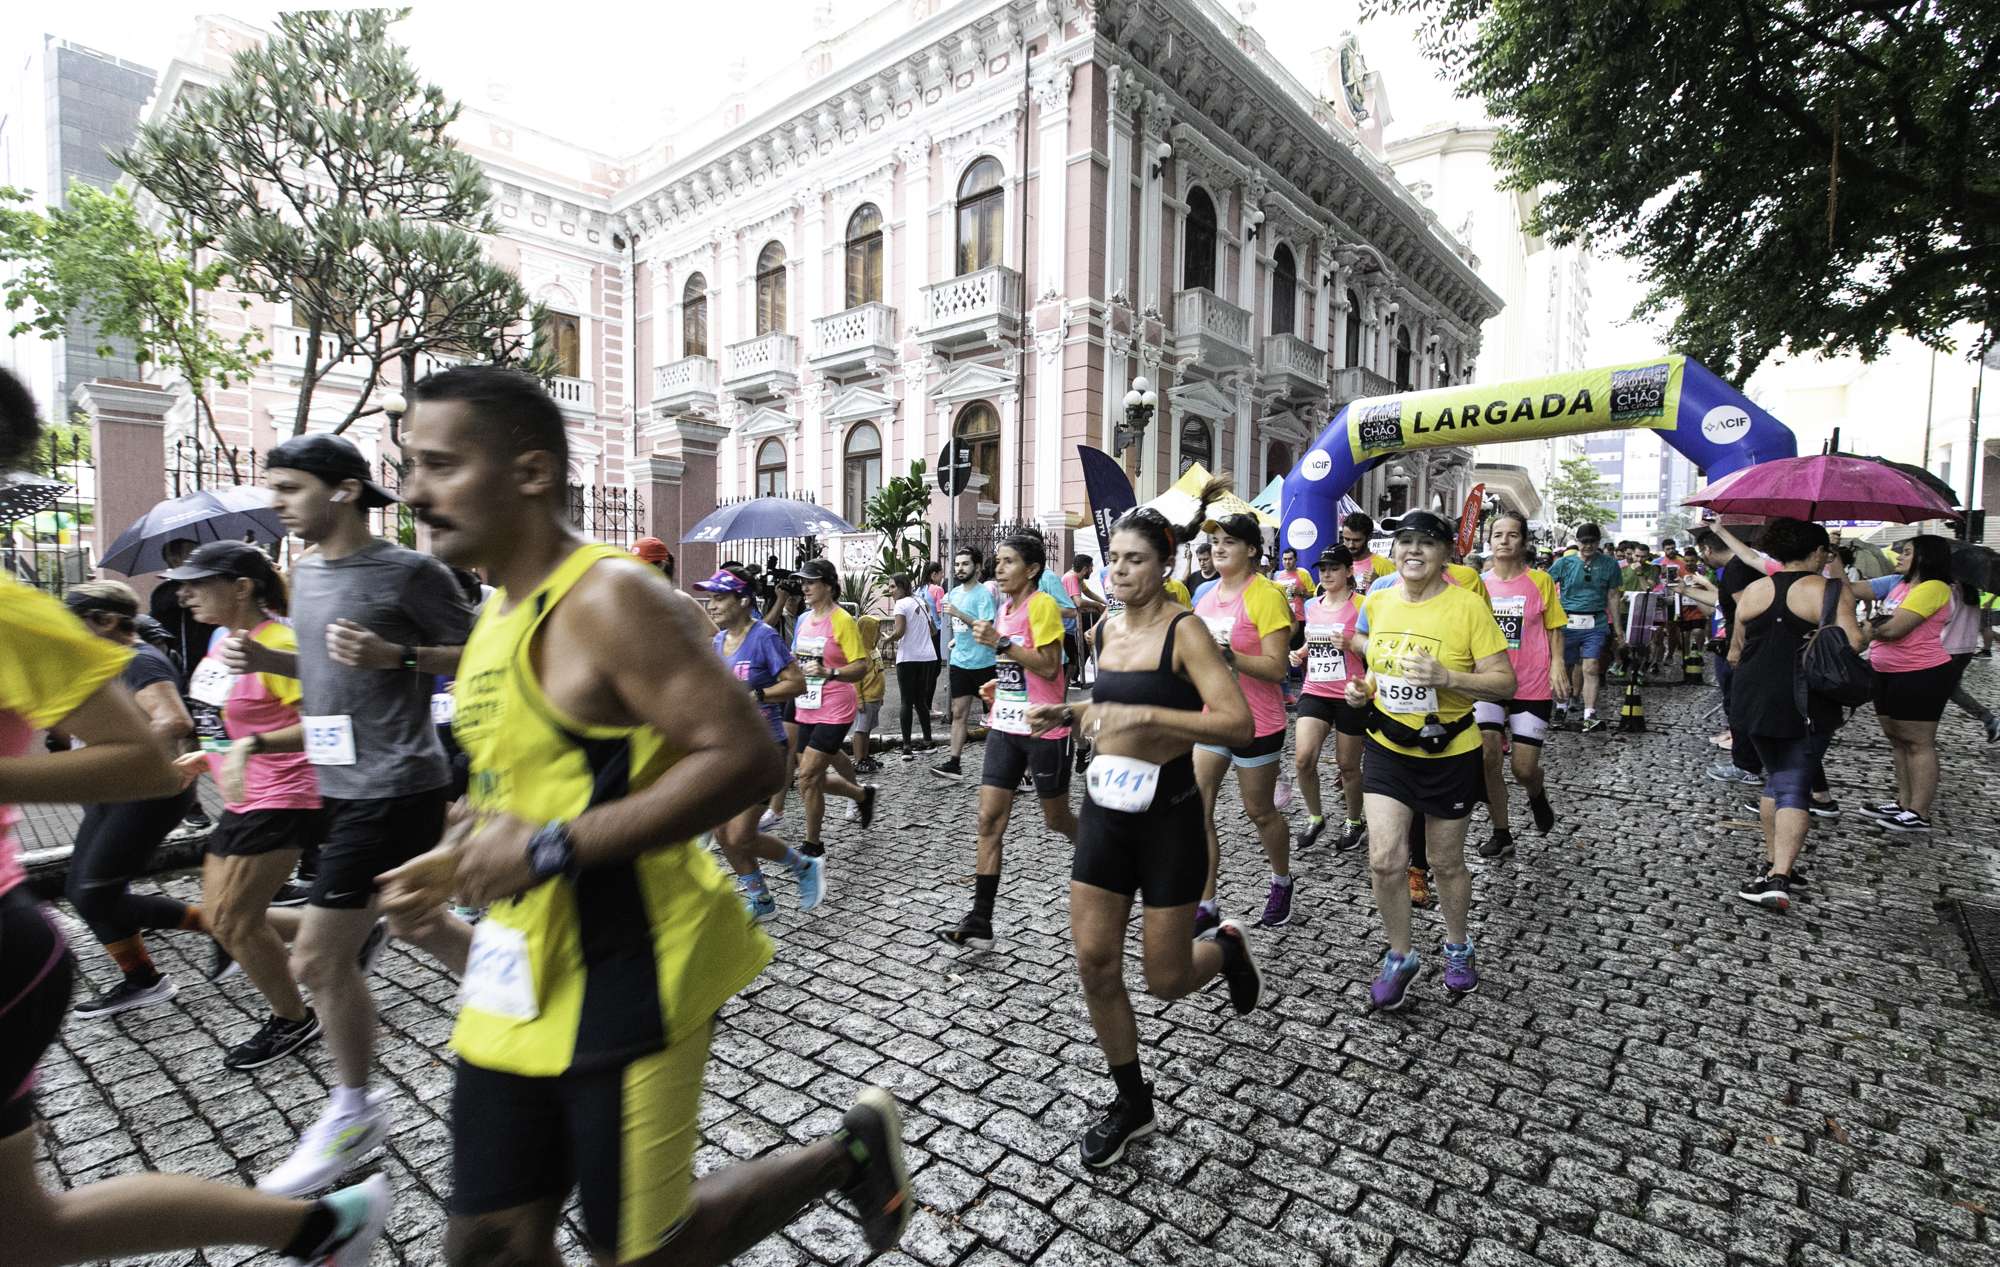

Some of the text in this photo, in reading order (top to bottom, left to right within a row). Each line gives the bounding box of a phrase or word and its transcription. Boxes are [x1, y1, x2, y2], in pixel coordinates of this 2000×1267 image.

[1617, 389, 1660, 405] CHÃO
[1413, 389, 1593, 434] LARGADA
[1363, 424, 1397, 437] CHÃO
[1716, 417, 1747, 430] ACIF
[1094, 510, 1107, 537] NDTV
[1317, 662, 1338, 673] 757
[1389, 685, 1427, 701] 598
[1104, 768, 1146, 793] 141
